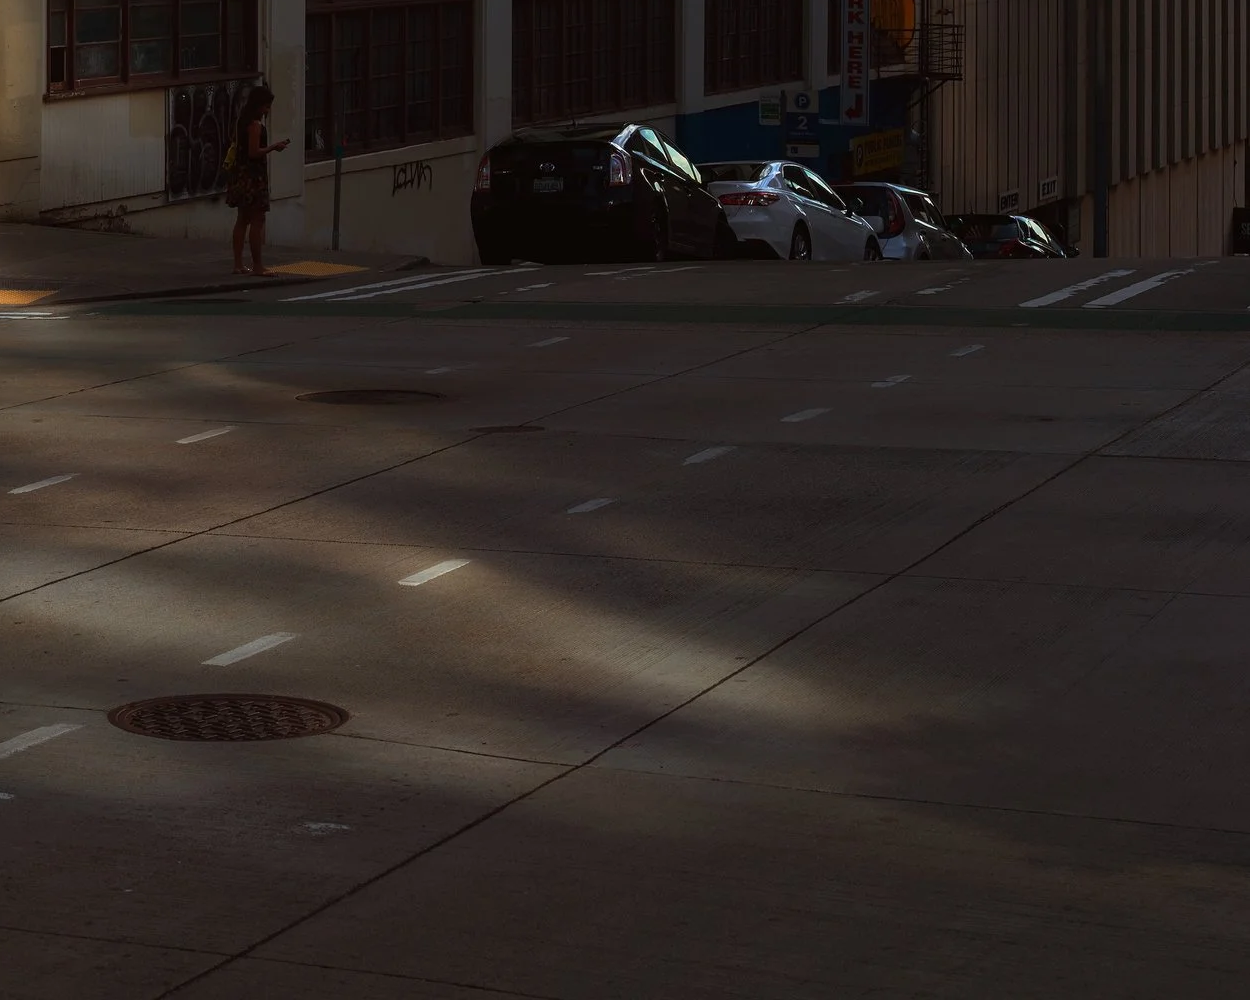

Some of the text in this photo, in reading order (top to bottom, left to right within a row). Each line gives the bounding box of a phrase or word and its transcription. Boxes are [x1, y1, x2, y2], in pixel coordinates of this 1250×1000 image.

[847, 30, 863, 89] HERE
[797, 115, 808, 131] 2
[1041, 179, 1057, 197] EXIT
